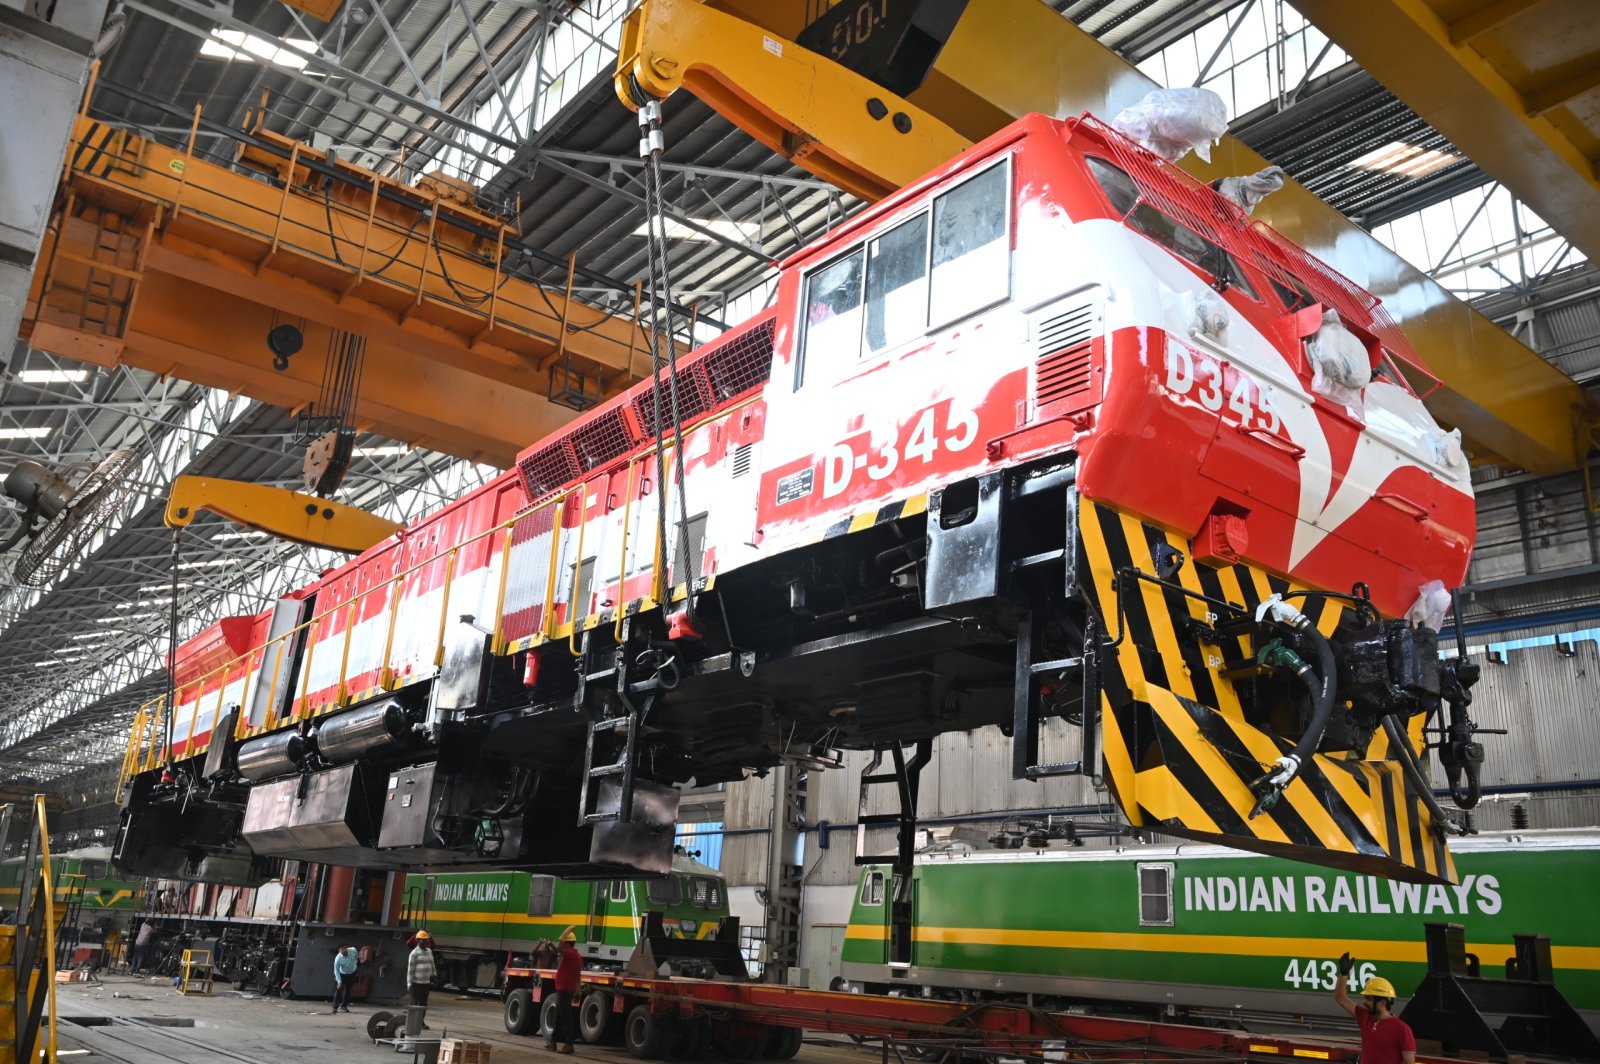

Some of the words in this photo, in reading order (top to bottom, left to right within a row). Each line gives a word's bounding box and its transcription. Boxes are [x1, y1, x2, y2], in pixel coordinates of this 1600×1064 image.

[1166, 338, 1281, 438] D345
[823, 396, 979, 499] D-345
[1205, 611, 1218, 625] FP
[1208, 654, 1221, 668] BP
[435, 883, 464, 902] INDIAN
[466, 883, 509, 902] RAILWAYS
[1184, 876, 1296, 913] INDIAN
[1304, 874, 1503, 916] RAILWAYS
